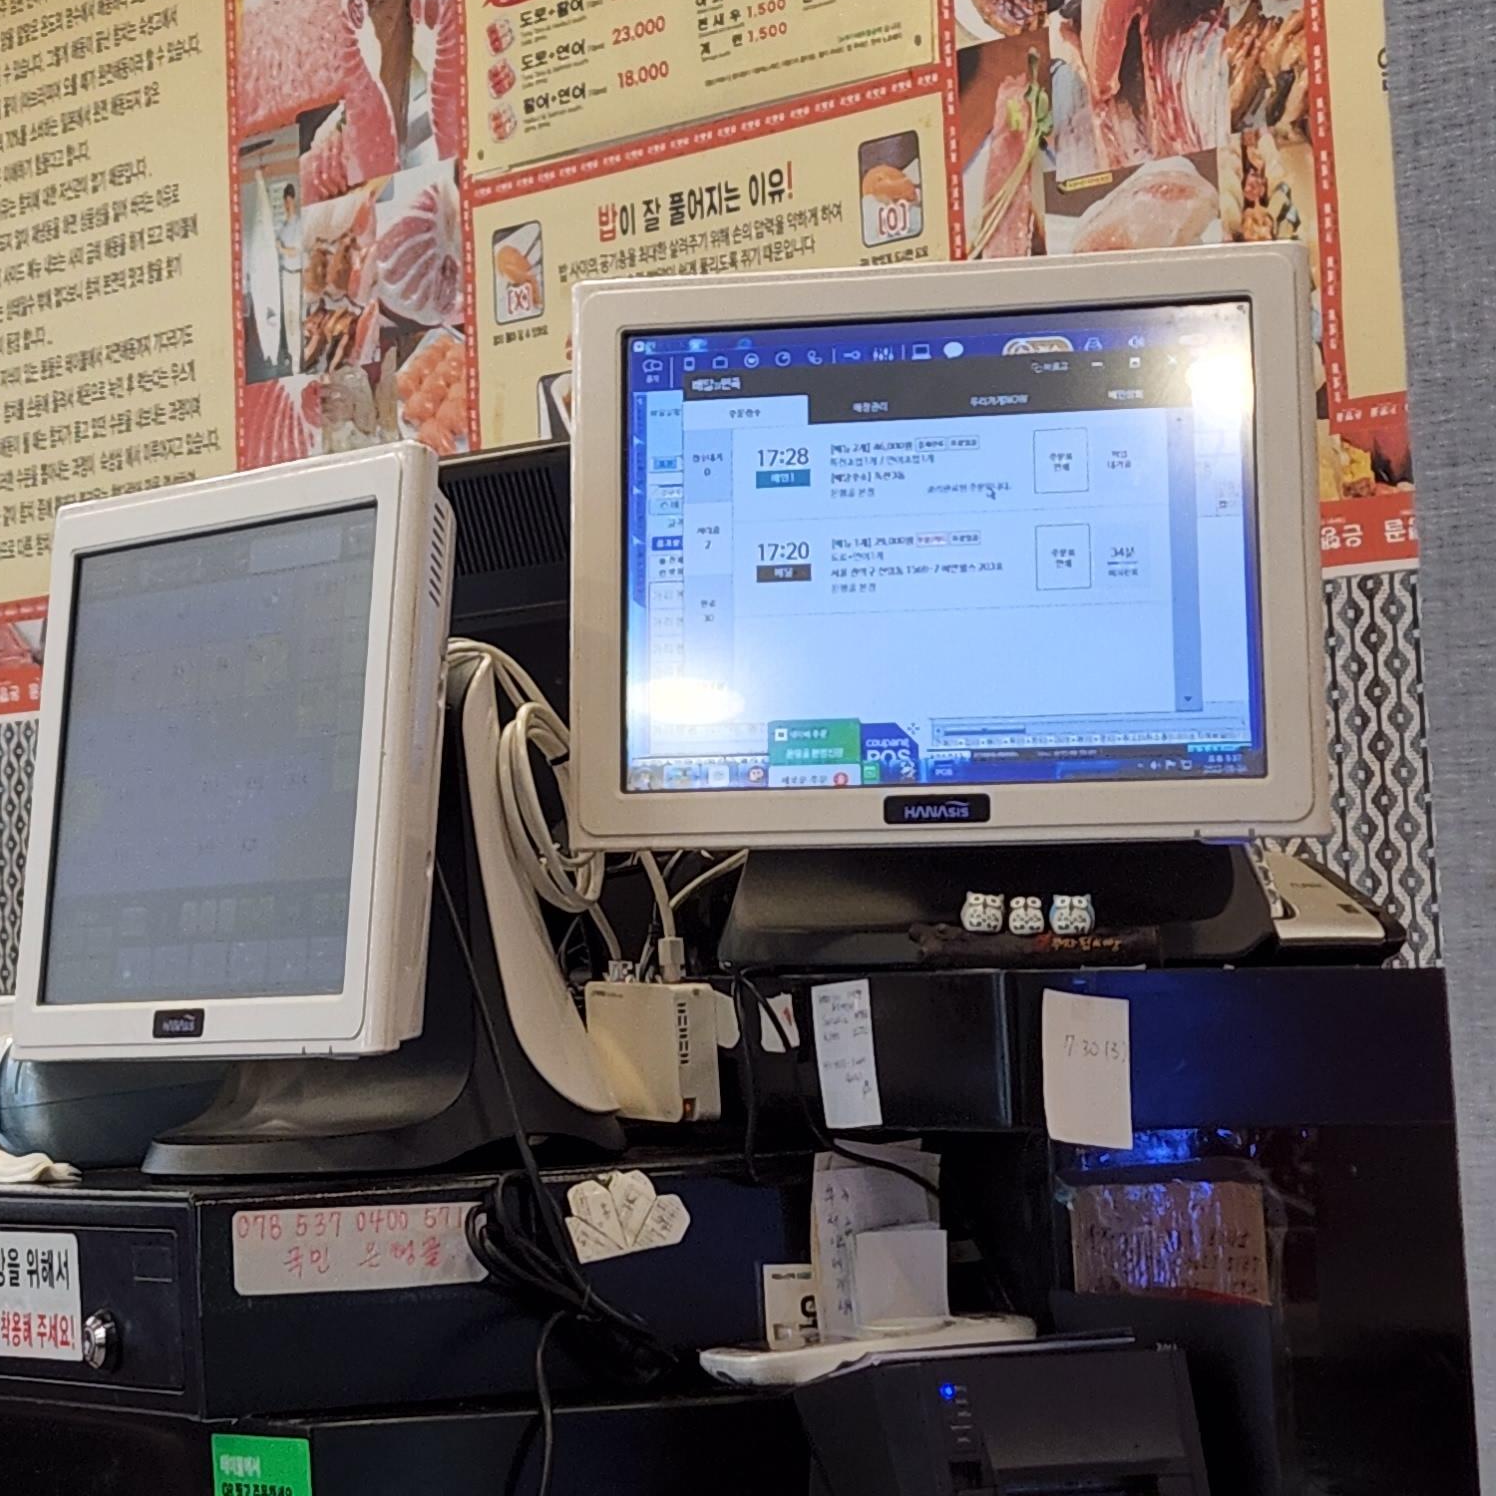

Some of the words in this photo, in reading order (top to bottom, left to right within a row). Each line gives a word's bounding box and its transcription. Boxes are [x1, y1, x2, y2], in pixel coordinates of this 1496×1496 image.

[612, 15, 665, 45] 23,000
[748, 22, 787, 42] 1,500
[617, 61, 669, 88] 18,000
[598, 203, 636, 243] 밥이
[642, 197, 661, 232] 잘
[669, 180, 741, 228] 풀어지는
[748, 161, 794, 207] 이유!
[758, 448, 809, 467] 17:28
[758, 542, 810, 561] 17:20
[236, 1214, 282, 1241] 078
[296, 1212, 342, 1238] 537
[356, 1208, 409, 1233] 0400
[26, 1248, 70, 1291] 위해서
[0, 1311, 33, 1349] 착용해
[36, 1313, 77, 1351] 주세요!
